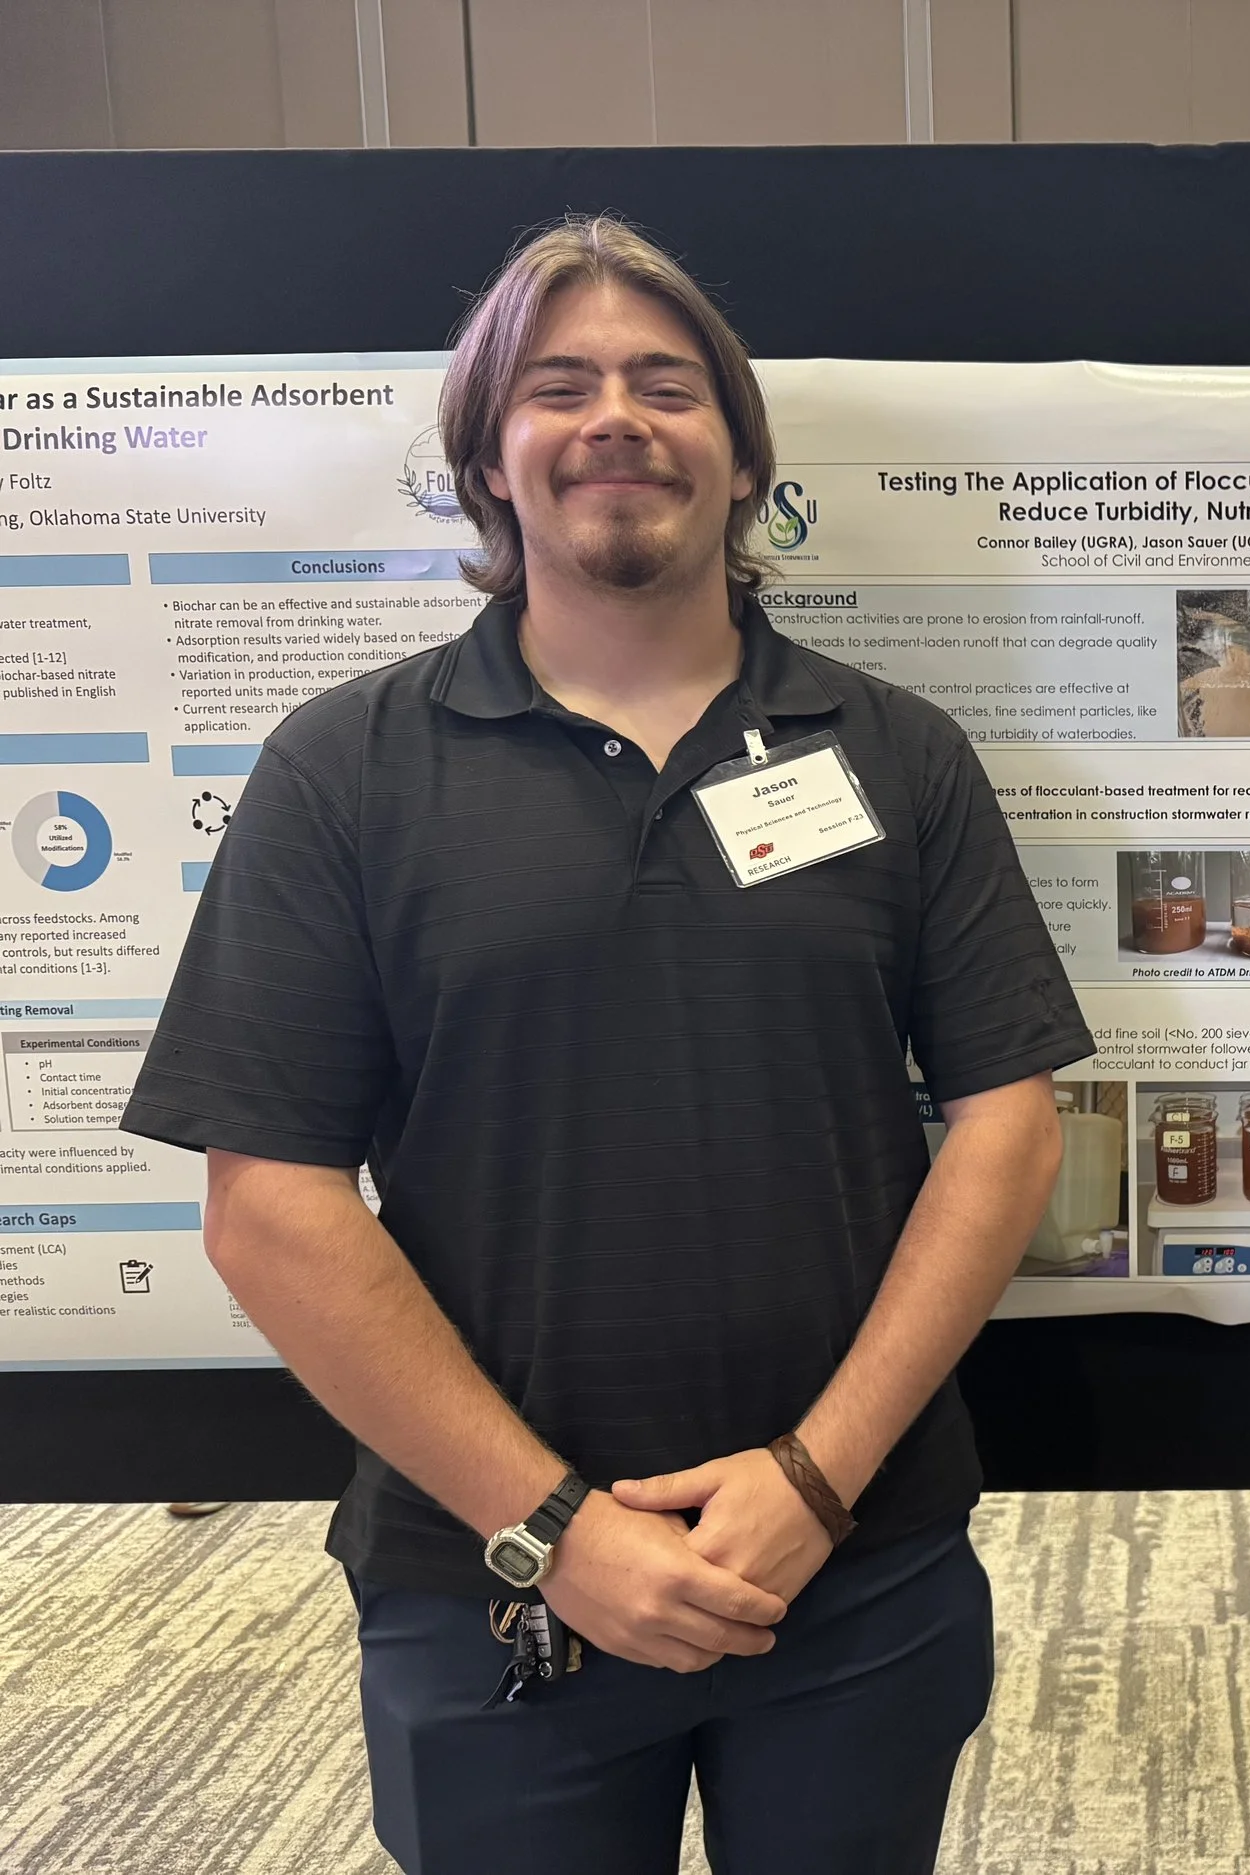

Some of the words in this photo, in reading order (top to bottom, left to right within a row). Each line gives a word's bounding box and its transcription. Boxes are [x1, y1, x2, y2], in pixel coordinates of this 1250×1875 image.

[26, 392, 54, 410] as
[62, 391, 77, 409] a
[86, 382, 242, 409] Sustainable
[251, 381, 394, 407] Adsorbent
[2, 425, 117, 455] Drinking
[123, 425, 207, 448] Water
[9, 471, 52, 490] Foltz
[877, 470, 957, 496] Testing
[964, 470, 1005, 491] The
[1012, 470, 1147, 496] Application
[1155, 469, 1178, 491] of
[29, 508, 120, 526] Oklahoma
[125, 508, 171, 525] State
[177, 506, 266, 527] University
[999, 500, 1088, 521] Reduce
[1094, 500, 1198, 526] Turbidity,
[977, 535, 1030, 549] Connor
[1034, 535, 1077, 552] Bailey
[1081, 534, 1137, 552] (UGRA),
[1142, 535, 1183, 549] Jason
[1187, 535, 1229, 548] Sauer
[291, 558, 385, 574] Conclusions
[1041, 553, 1090, 567] School
[1093, 552, 1108, 567] of
[1111, 553, 1141, 567] Civil
[1144, 553, 1174, 567] and
[171, 599, 217, 612] Biochar
[219, 601, 240, 611] can
[242, 598, 258, 611] be
[260, 601, 276, 611] an
[278, 597, 328, 610] effective
[330, 597, 353, 610] and
[355, 595, 420, 609] sustainable
[423, 595, 482, 608] adsorbent
[752, 776, 799, 798] Jason
[767, 794, 795, 808] Sauer
[735, 825, 764, 837] Physical
[764, 815, 793, 827] Sciences
[794, 809, 806, 818] and
[806, 796, 842, 813] Technology
[818, 820, 847, 834] Session
[847, 813, 864, 824] F-23
[747, 855, 792, 876] RESEARCH
[99, 912, 140, 925] Among
[1132, 967, 1161, 977] Photo
[1163, 967, 1193, 977] credit
[1194, 967, 1205, 977] to
[1207, 967, 1236, 977] ATDM
[19, 1037, 85, 1051] Experimental
[86, 1036, 140, 1048] Conditions
[39, 1072, 78, 1083] Contact
[78, 1071, 102, 1082] time
[1170, 1135, 1184, 1144] F-5
[38, 1212, 77, 1228] Gaps
